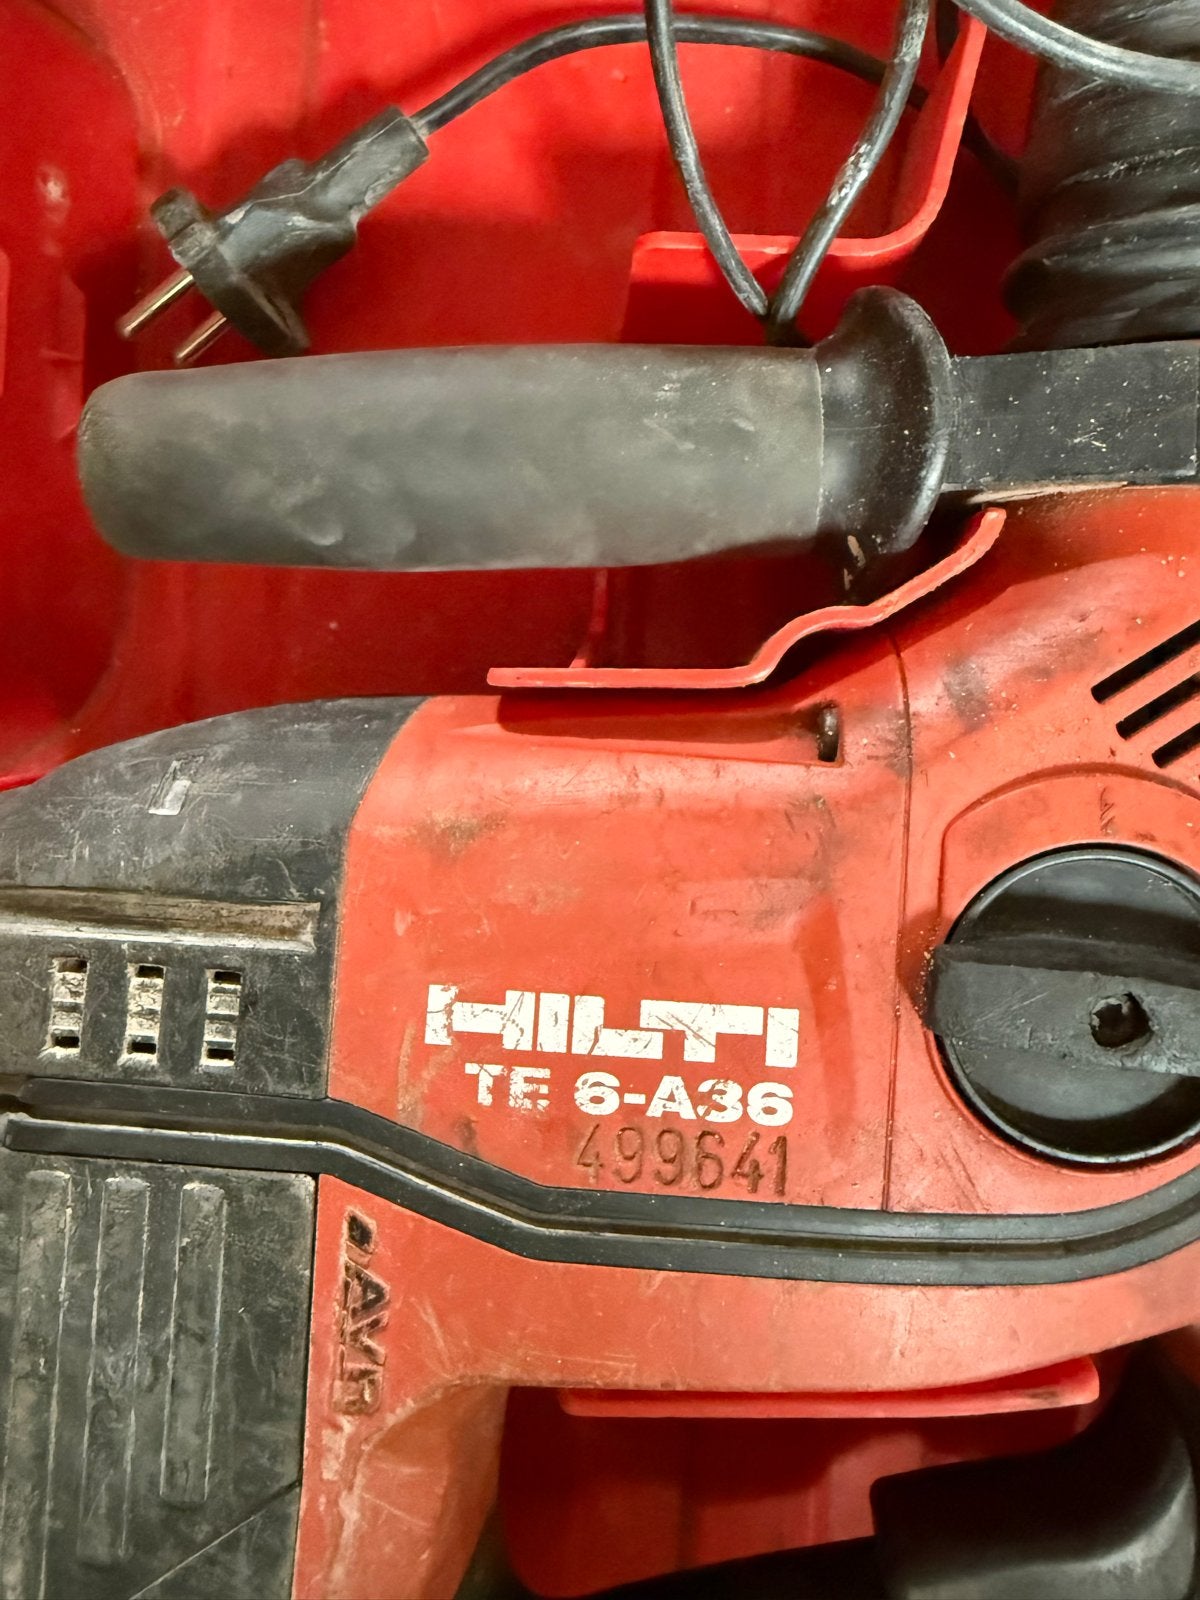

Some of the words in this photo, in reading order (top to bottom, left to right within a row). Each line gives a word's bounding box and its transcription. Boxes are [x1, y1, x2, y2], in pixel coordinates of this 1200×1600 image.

[425, 984, 799, 1068] HILTI
[464, 1062, 551, 1112] TE
[574, 1071, 794, 1126] 6-A36
[577, 1124, 789, 1196] 499641
